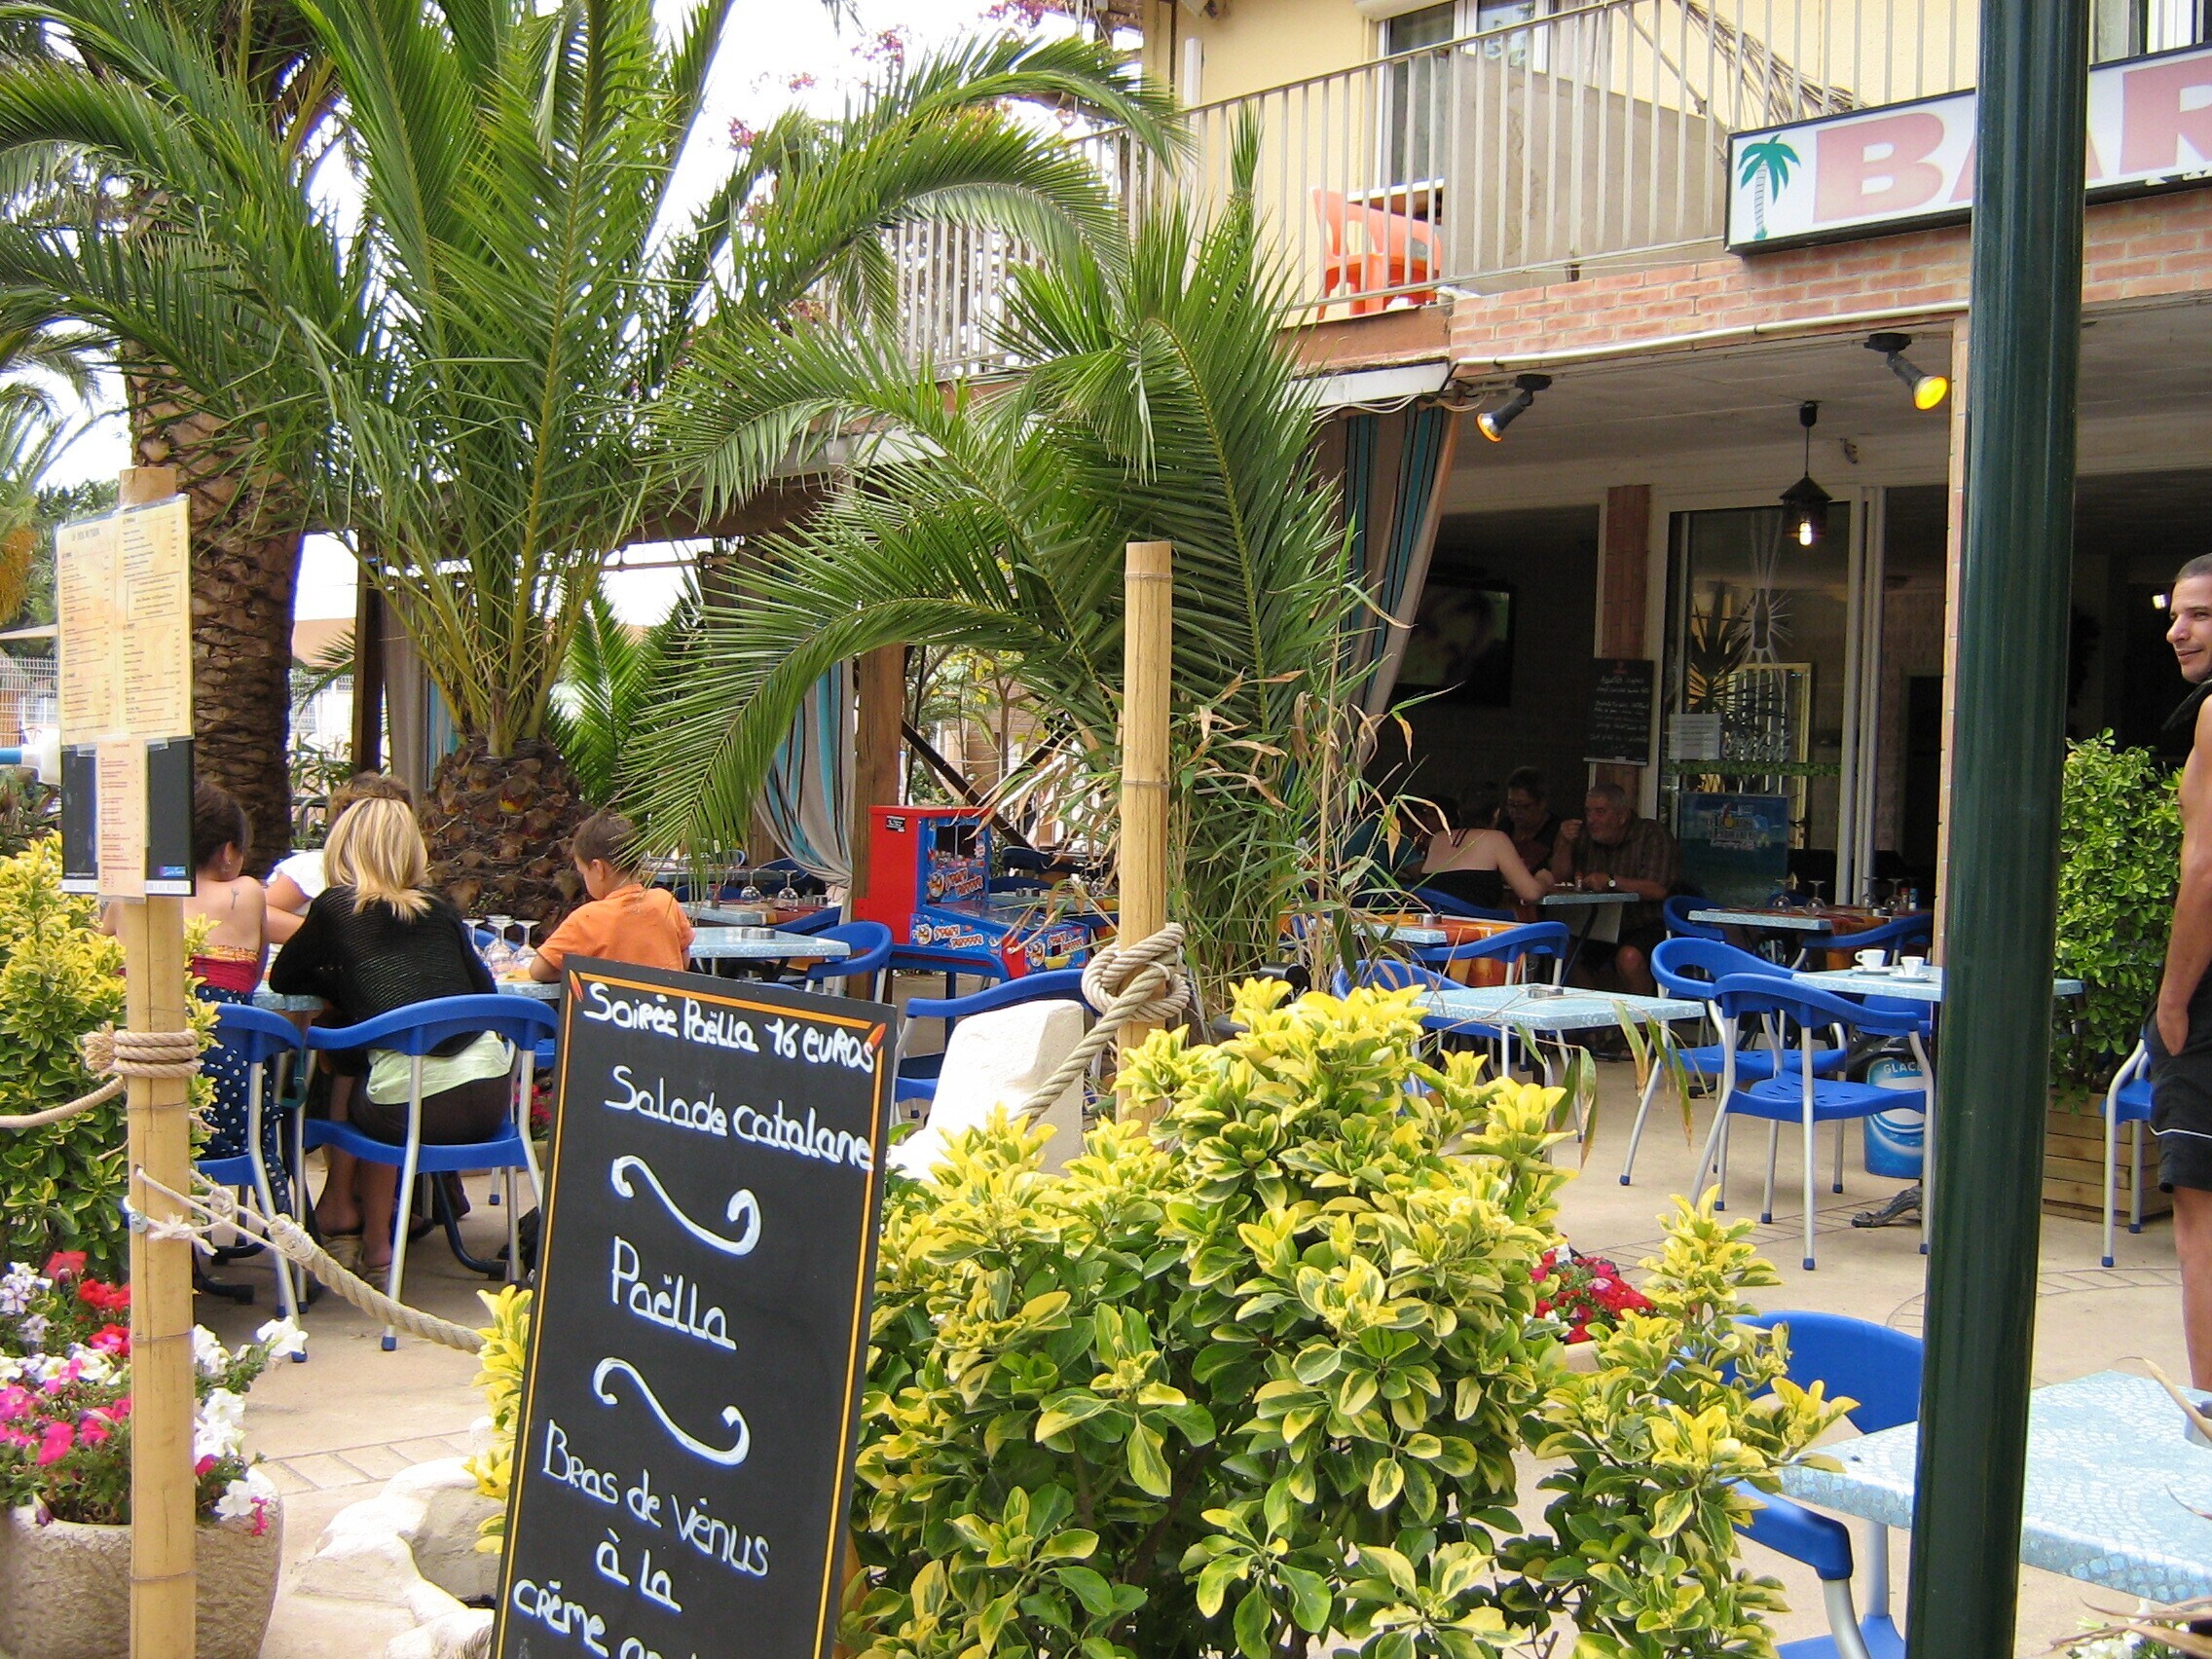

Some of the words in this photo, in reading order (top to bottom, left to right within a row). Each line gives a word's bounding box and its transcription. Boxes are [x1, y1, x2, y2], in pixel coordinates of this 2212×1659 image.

[1813, 55, 2212, 224] BR
[765, 1017, 796, 1059] 16
[604, 1065, 729, 1137] Salade
[610, 1235, 738, 1350] Paëlla
[627, 1469, 662, 1528] de
[596, 1528, 630, 1586] à
[640, 1548, 682, 1612] la
